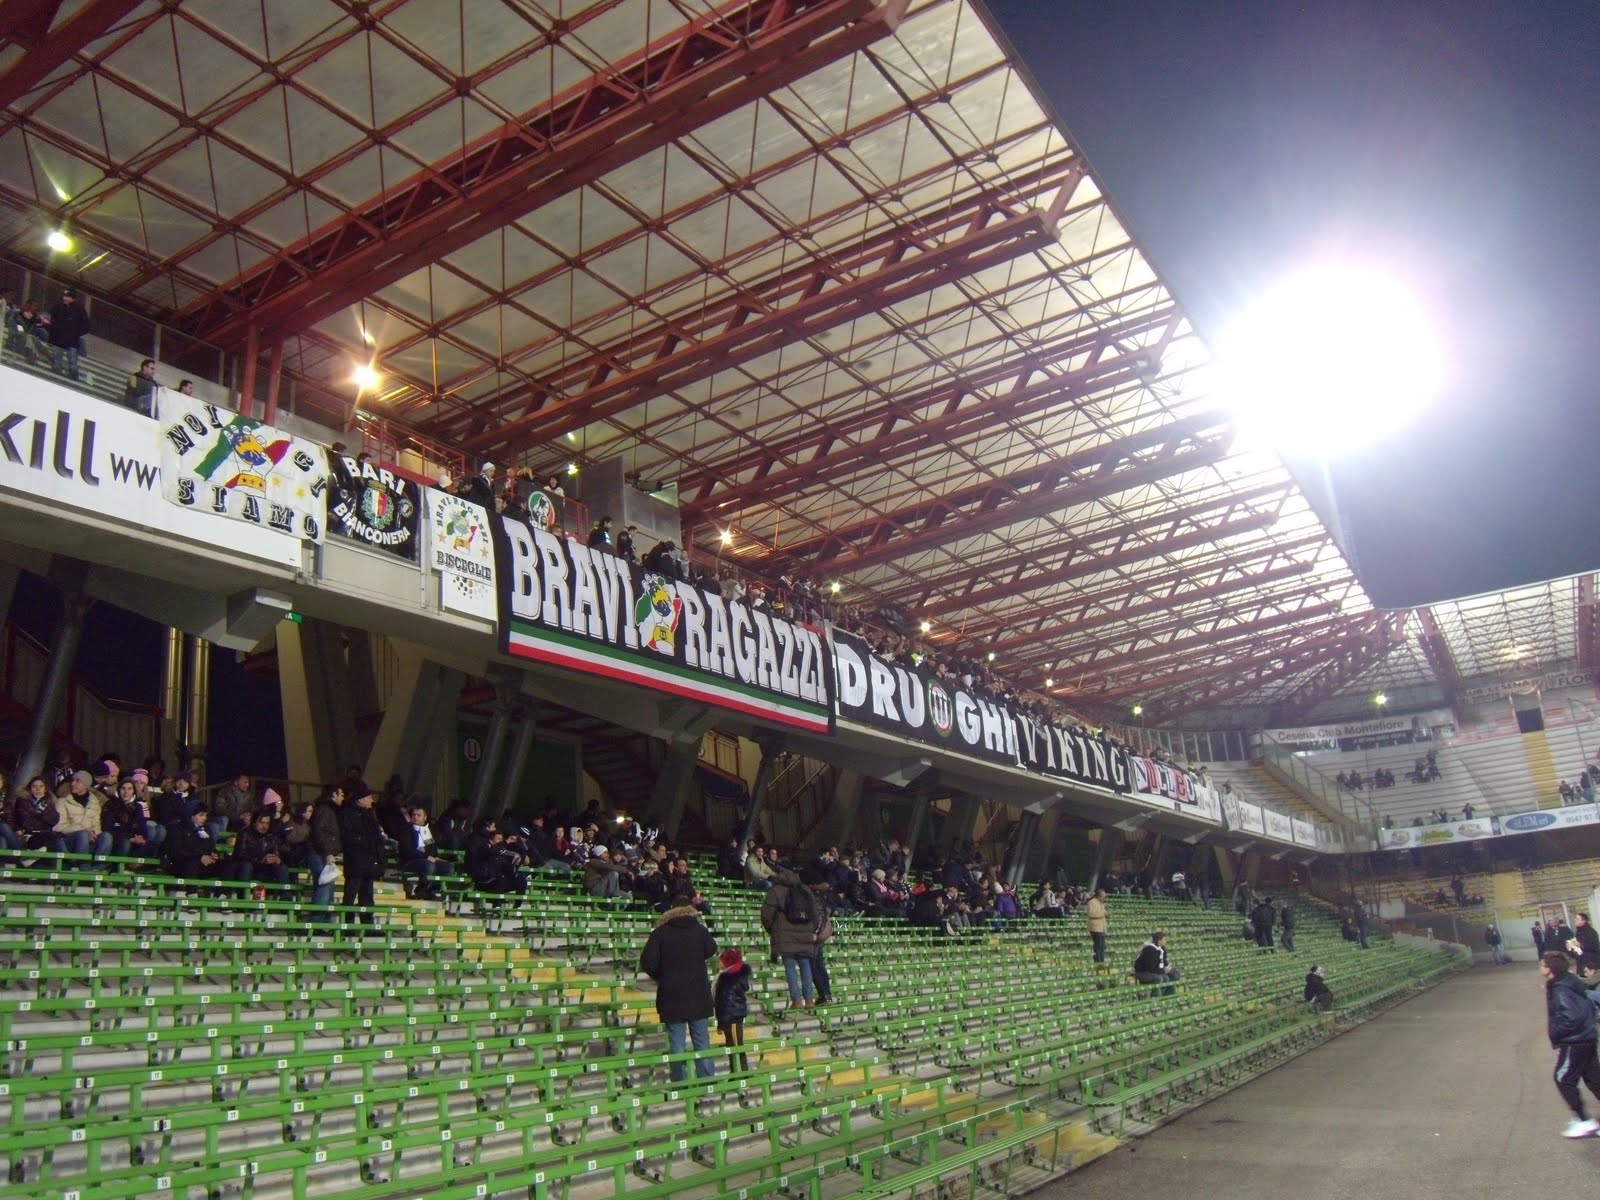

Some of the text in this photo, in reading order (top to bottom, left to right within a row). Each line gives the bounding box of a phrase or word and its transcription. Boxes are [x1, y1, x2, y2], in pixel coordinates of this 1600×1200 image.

[165, 404, 223, 456] NOI
[342, 456, 406, 496] BARI
[177, 476, 319, 541] SIAMO
[333, 502, 411, 546] BIANCONERA
[435, 496, 452, 527] BRAVI
[436, 550, 492, 582] BISCEGLIE
[502, 516, 828, 705] BRAVI RAGAZZI
[1016, 713, 1125, 786] VIKING
[1278, 731, 1315, 742] Cesena
[1317, 727, 1342, 738] Club
[1343, 720, 1404, 735] Montefiore
